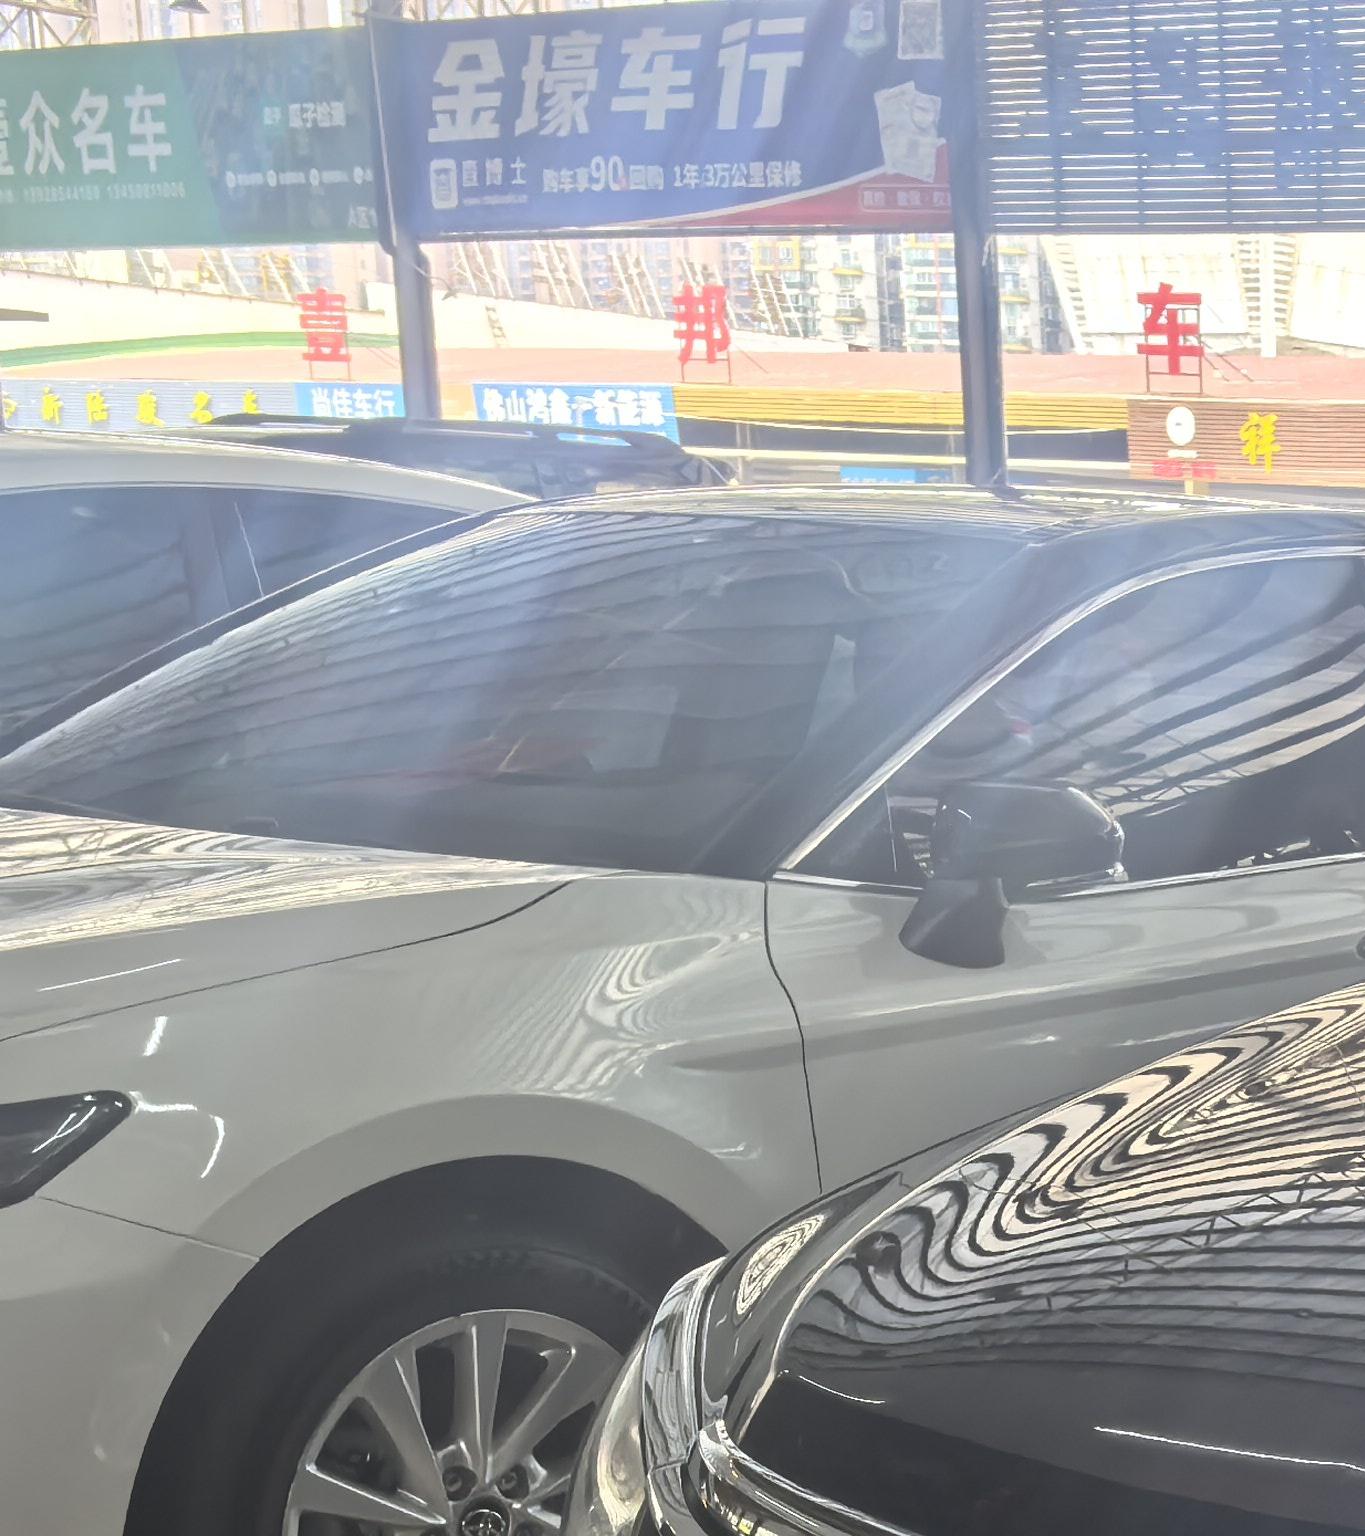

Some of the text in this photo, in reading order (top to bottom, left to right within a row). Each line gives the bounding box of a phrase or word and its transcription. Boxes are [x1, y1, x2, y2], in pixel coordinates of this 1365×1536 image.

[428, 17, 806, 143] 金壕车行
[1136, 282, 1203, 375] 车
